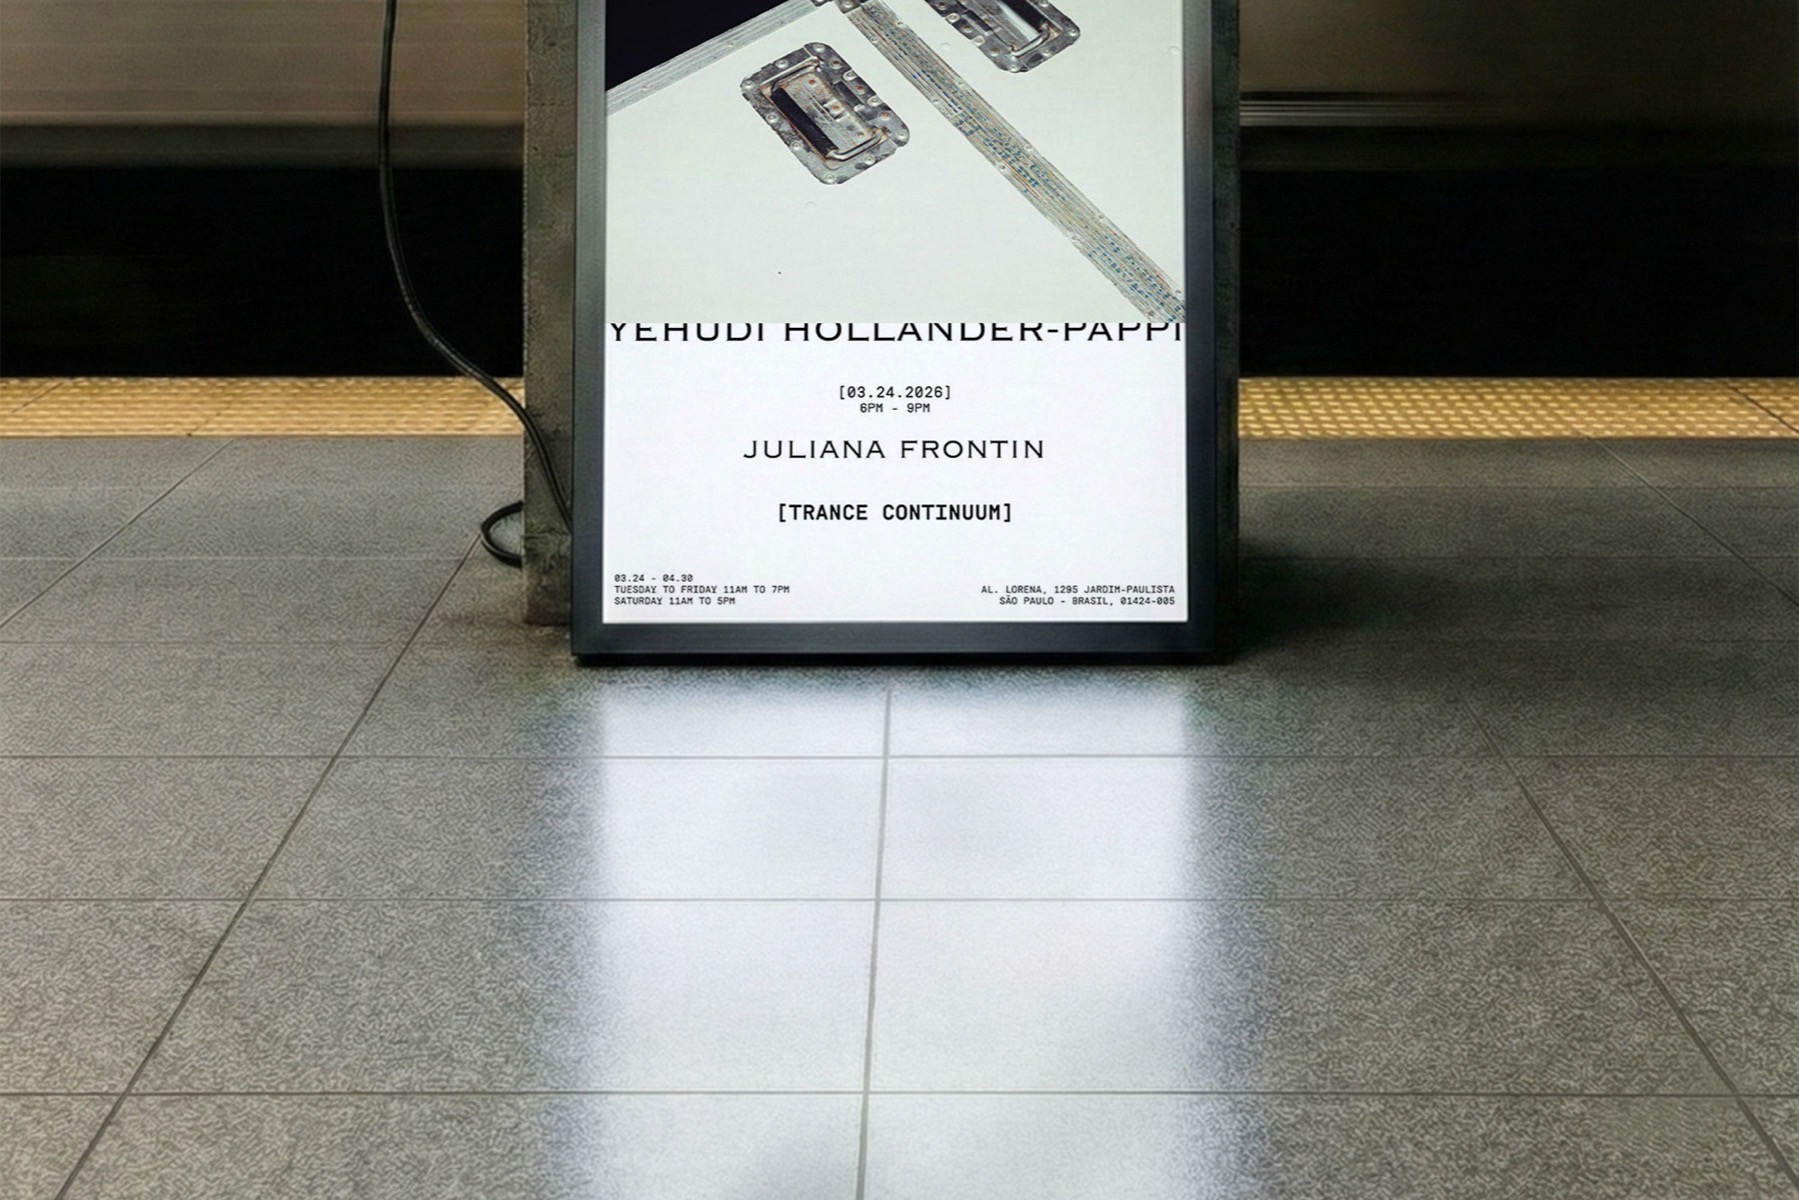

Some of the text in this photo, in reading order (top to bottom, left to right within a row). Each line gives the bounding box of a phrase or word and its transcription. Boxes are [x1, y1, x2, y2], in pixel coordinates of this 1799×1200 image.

[611, 323, 1181, 341] YEHUDI HOLLANDER-PAPPI
[840, 385, 950, 400] [03.24.2026]
[860, 403, 883, 413] 6PM
[907, 403, 930, 413] 9PM
[743, 440, 1043, 458] JULIANA FRONTIN
[779, 503, 1010, 522] [TRANCE CONTINUUM]
[613, 574, 644, 582] 03.24
[662, 574, 693, 582] 04.30
[614, 585, 789, 594] TUESDAY TO FRIDAY 11AM TO 7PM
[981, 585, 1175, 594] AL. LORENA, 1295 JARDIM-PAULISTA
[614, 597, 735, 605] SATURDAY 11AM TO 5PM
[1000, 595, 1018, 605] SÃO
[1024, 597, 1054, 605] PAULO
[1072, 597, 1113, 606] BRASIL,
[1119, 597, 1175, 605] 01424-005
